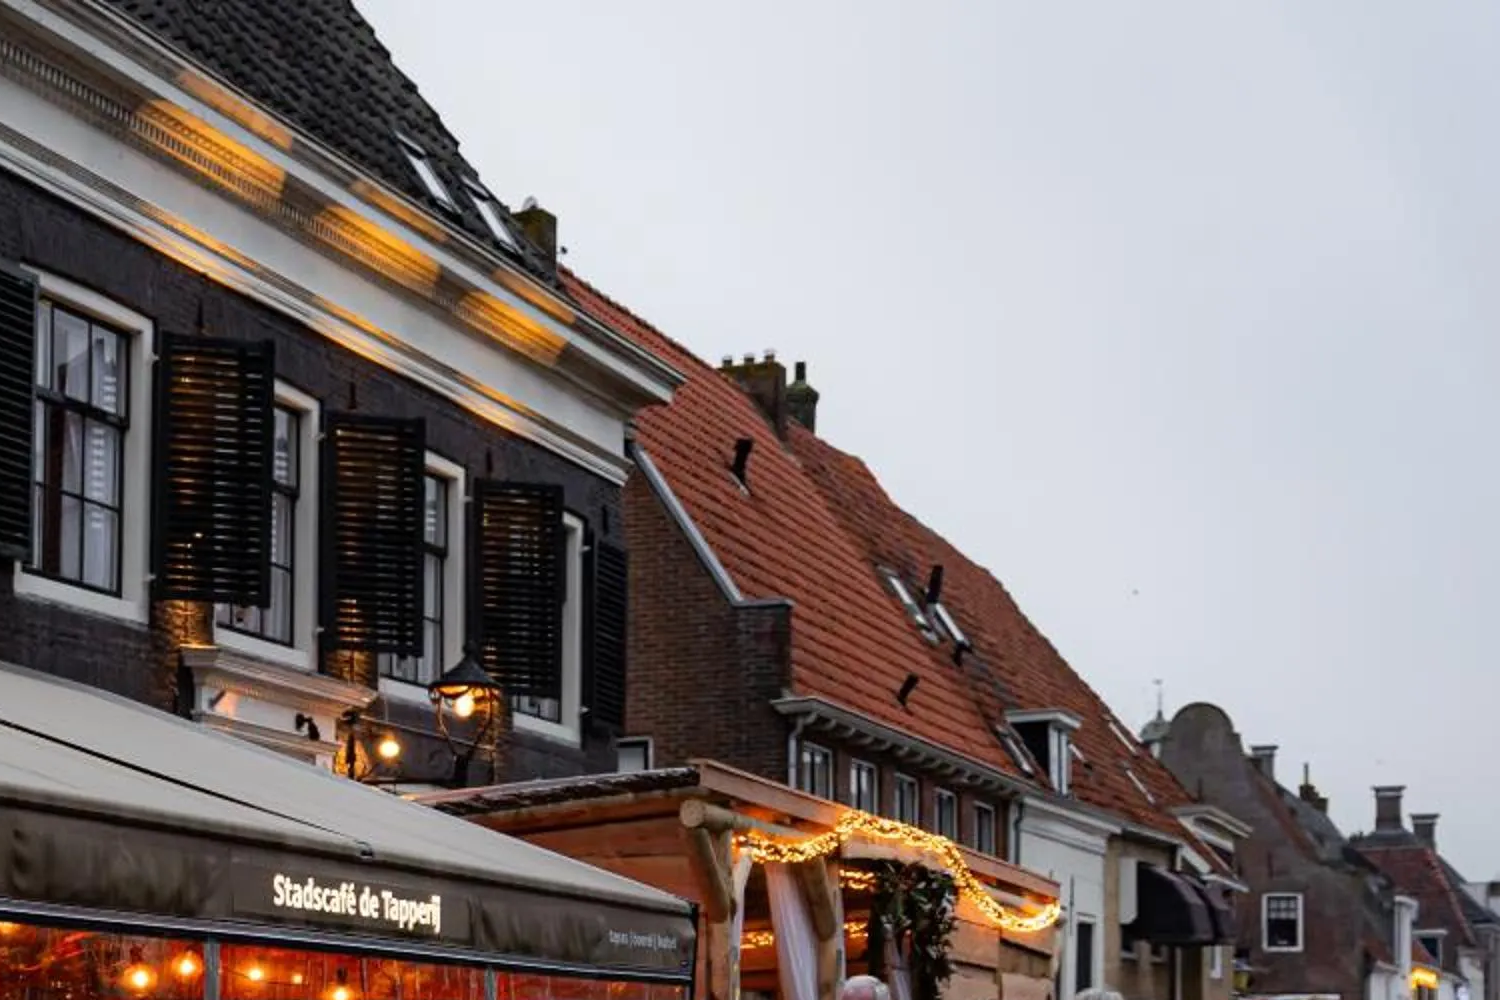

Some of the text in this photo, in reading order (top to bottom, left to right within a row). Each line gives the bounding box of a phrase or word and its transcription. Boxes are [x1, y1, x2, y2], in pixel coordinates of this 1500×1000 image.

[273, 873, 442, 935] Stadscafé de Tapperij
